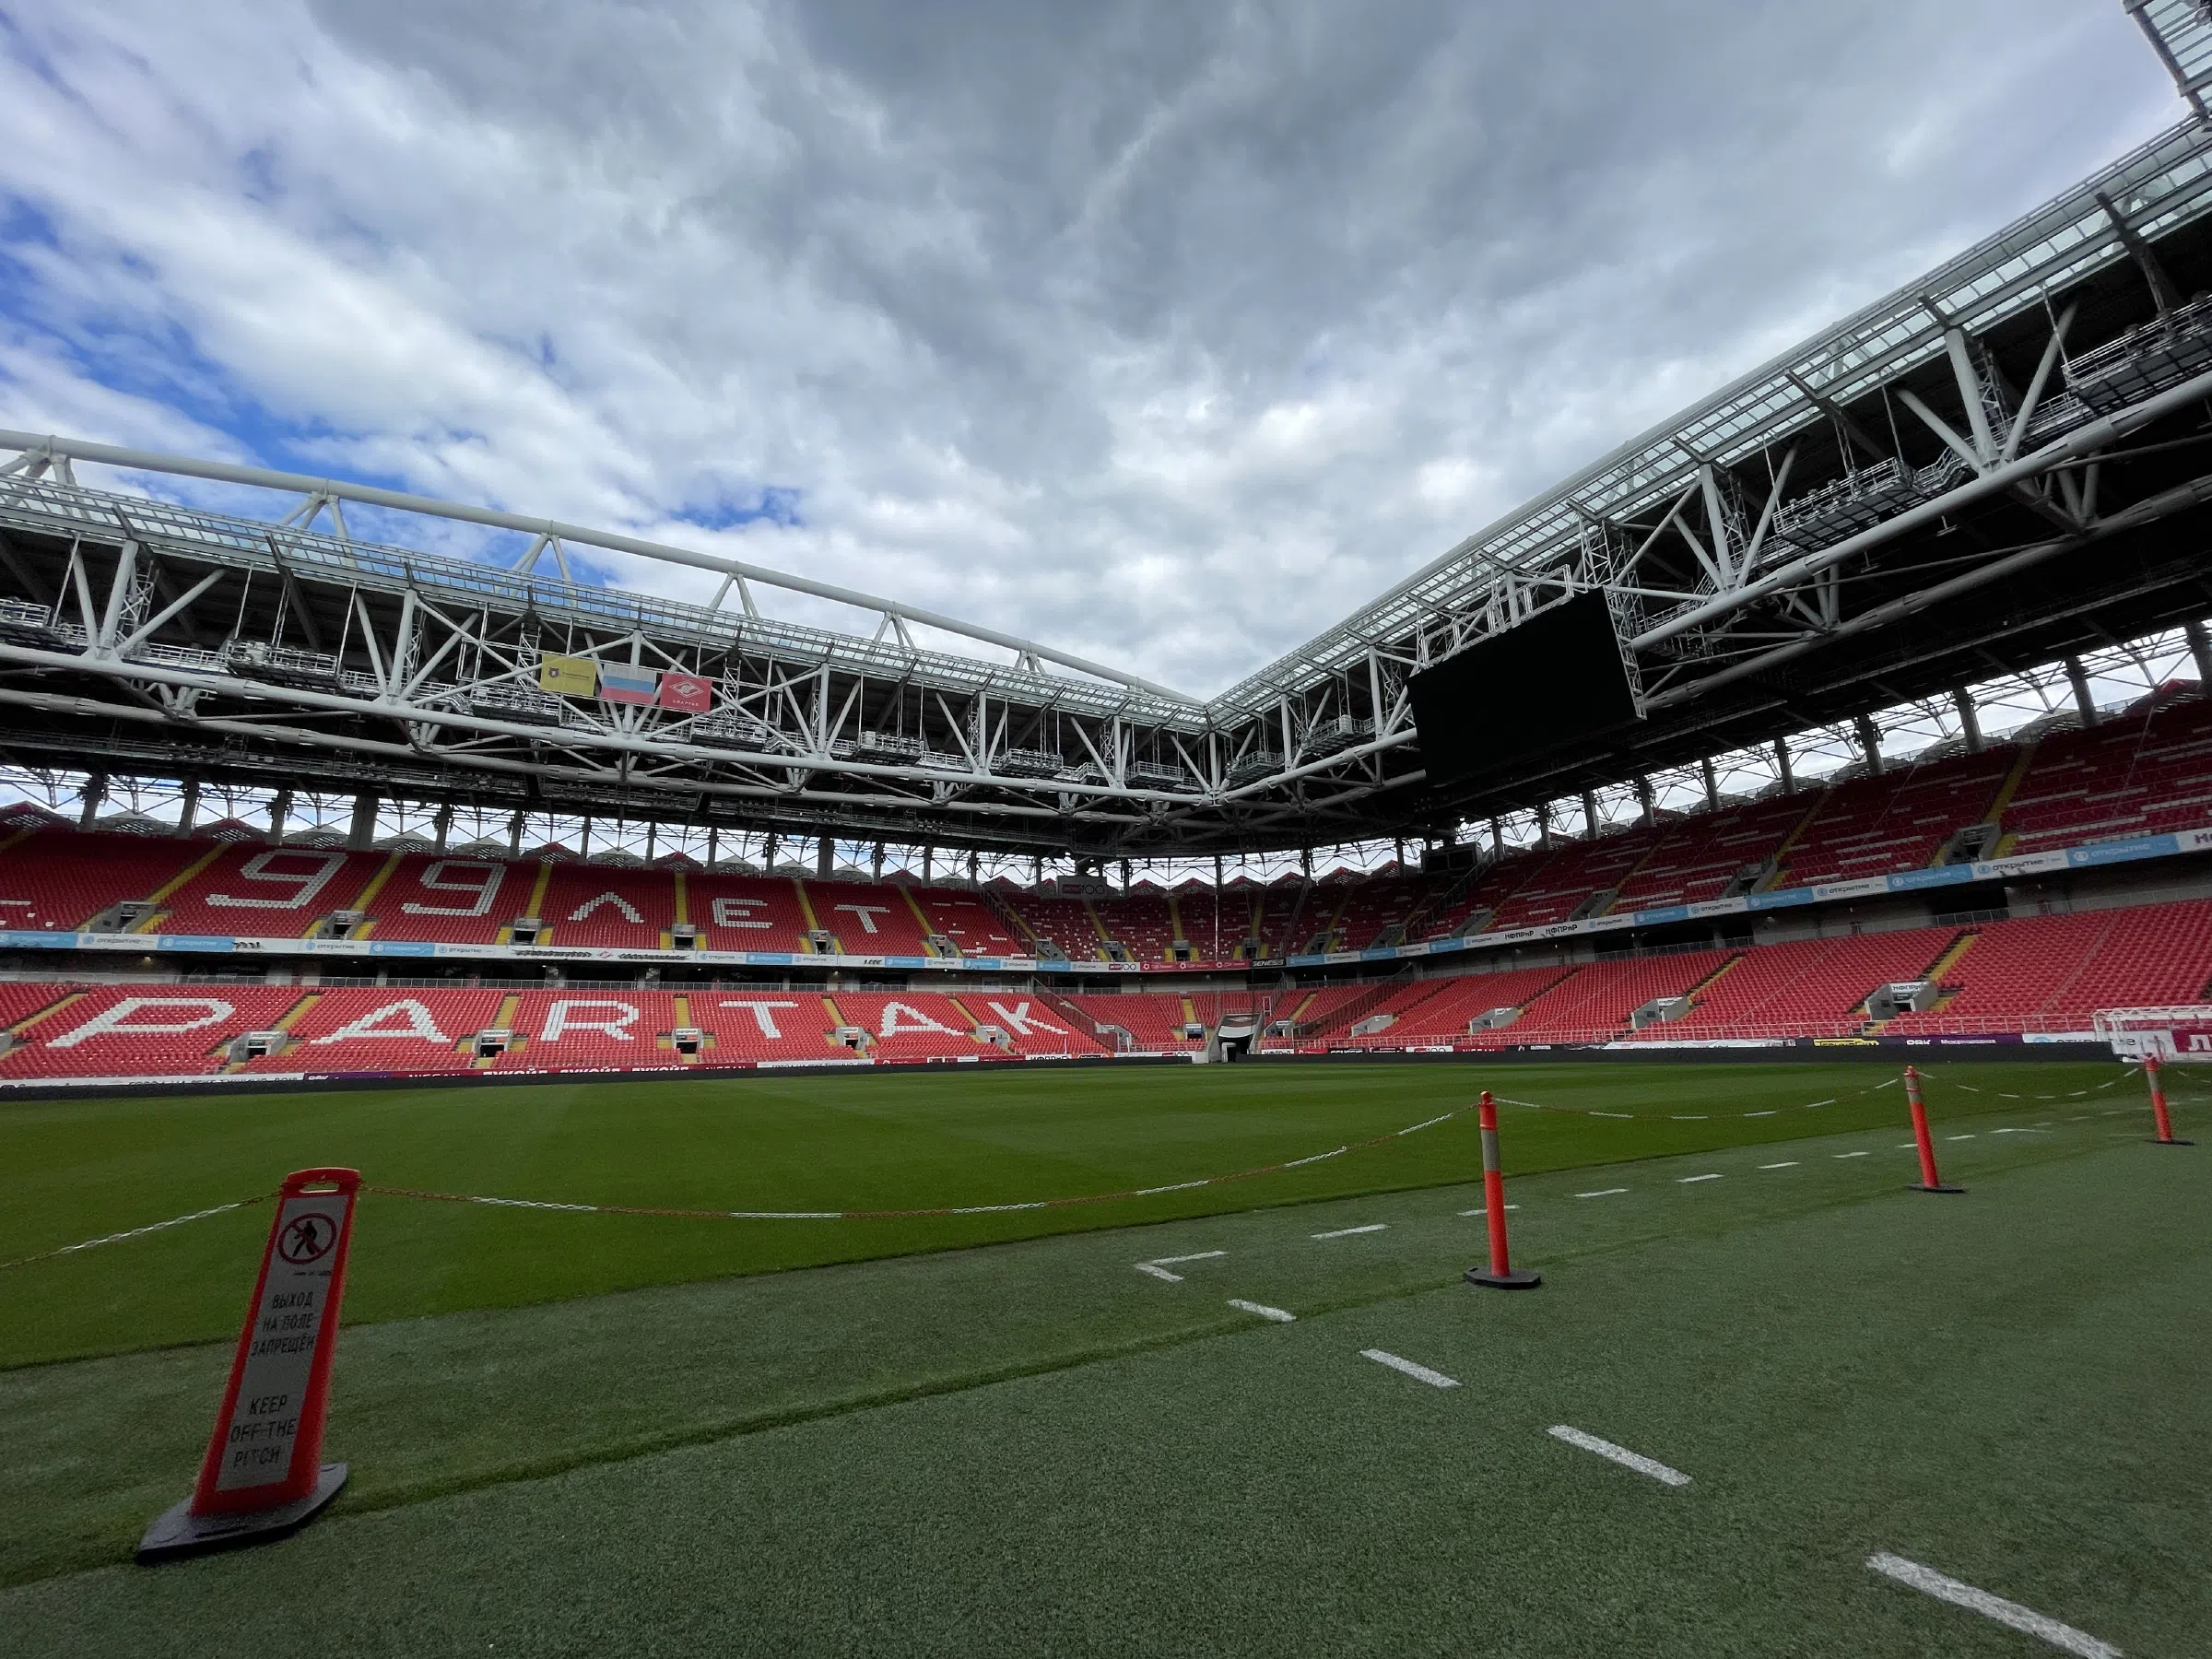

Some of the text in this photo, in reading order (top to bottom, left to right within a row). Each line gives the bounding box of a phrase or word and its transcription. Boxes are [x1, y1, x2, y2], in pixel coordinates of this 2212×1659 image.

[272, 1291, 313, 1309] ВЫХОД
[263, 1312, 314, 1333] НА ПОЛЕ
[249, 1394, 288, 1416] KEEP
[230, 1418, 298, 1443] OFF THE
